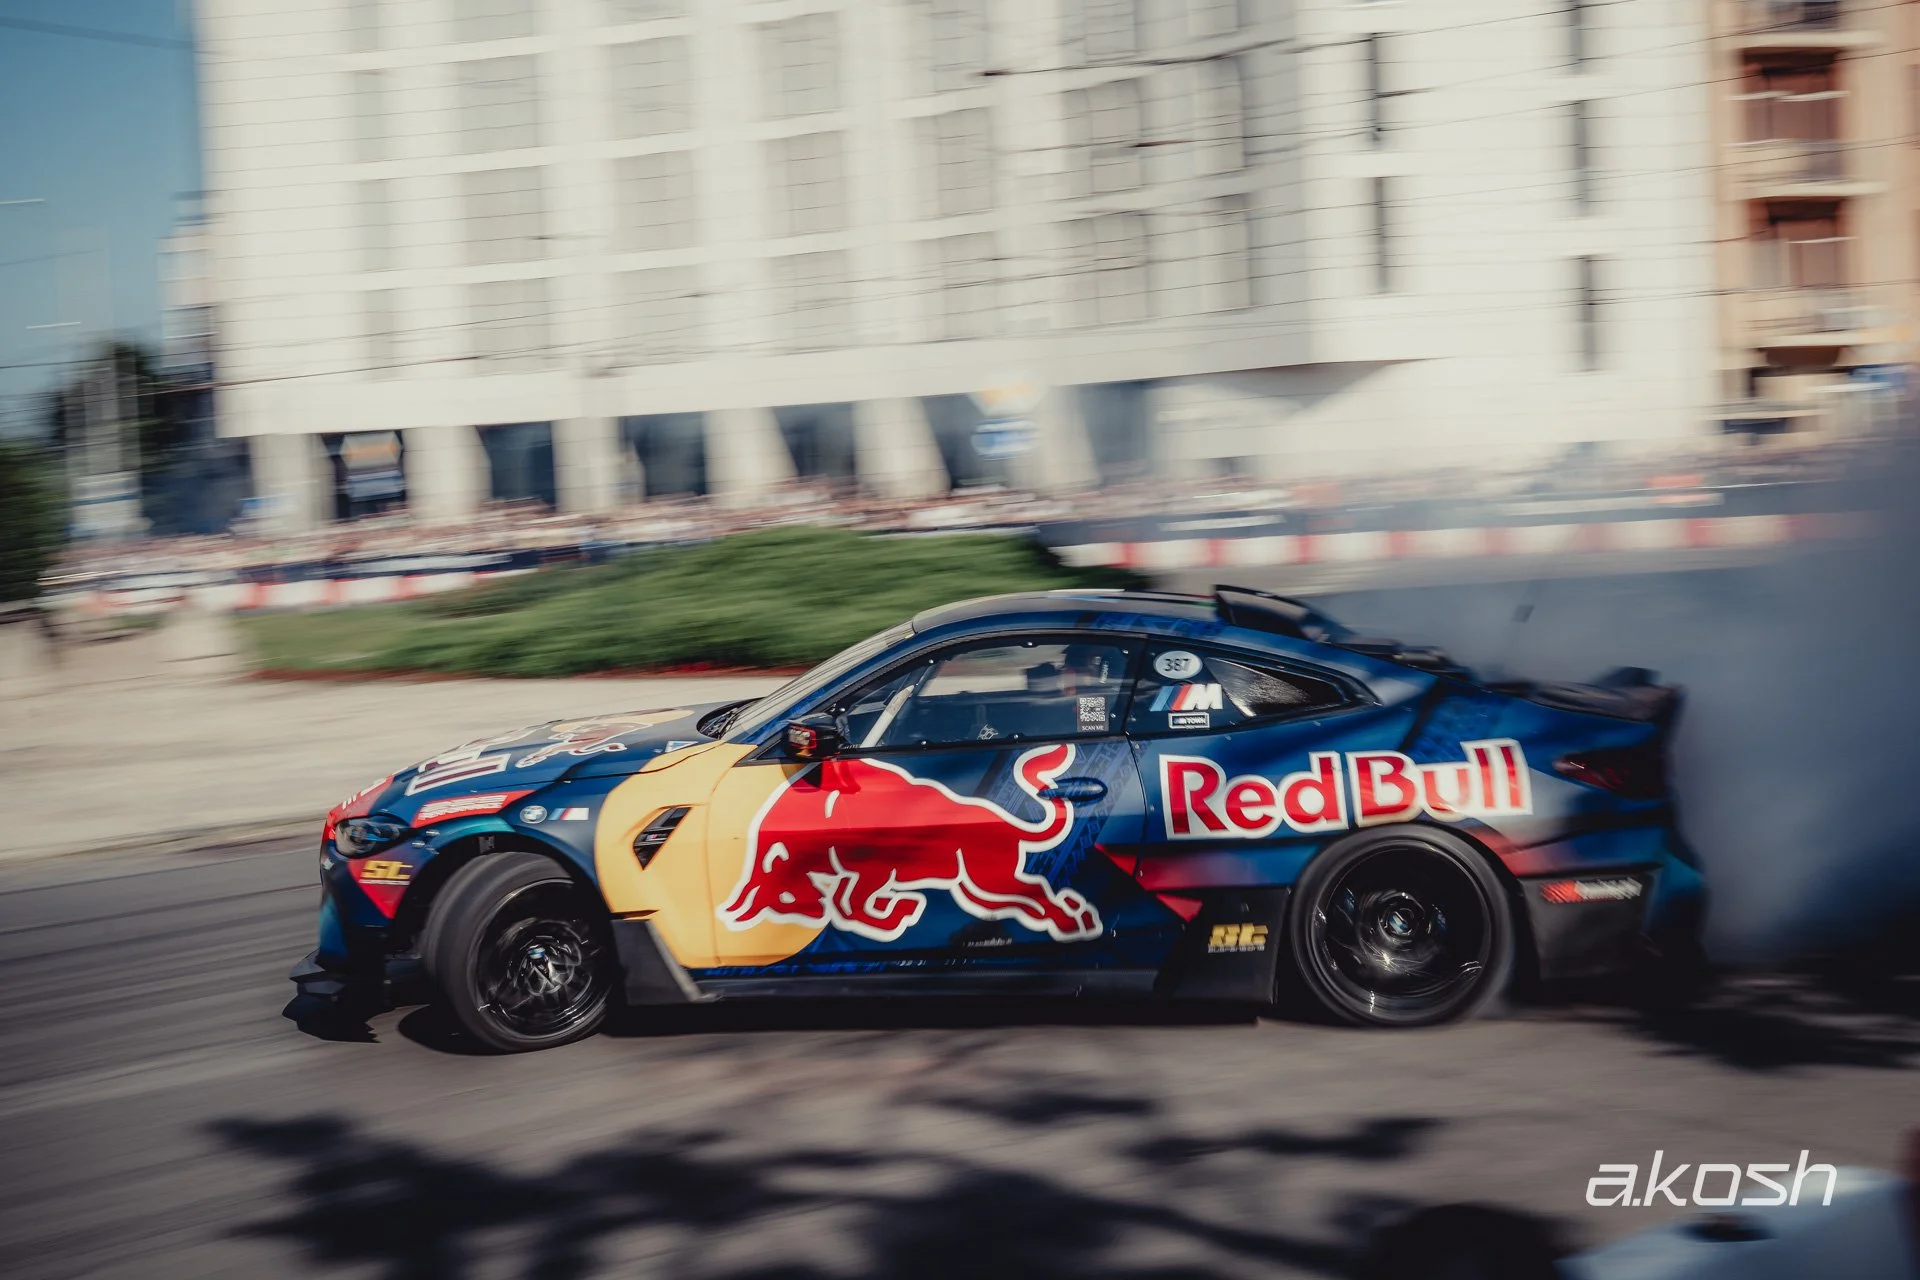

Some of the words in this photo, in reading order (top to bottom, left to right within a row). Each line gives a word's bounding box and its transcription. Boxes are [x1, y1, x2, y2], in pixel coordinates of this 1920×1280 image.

[1164, 658, 1191, 672] 387
[1160, 755, 1347, 839] Red
[1347, 738, 1532, 826] Bull
